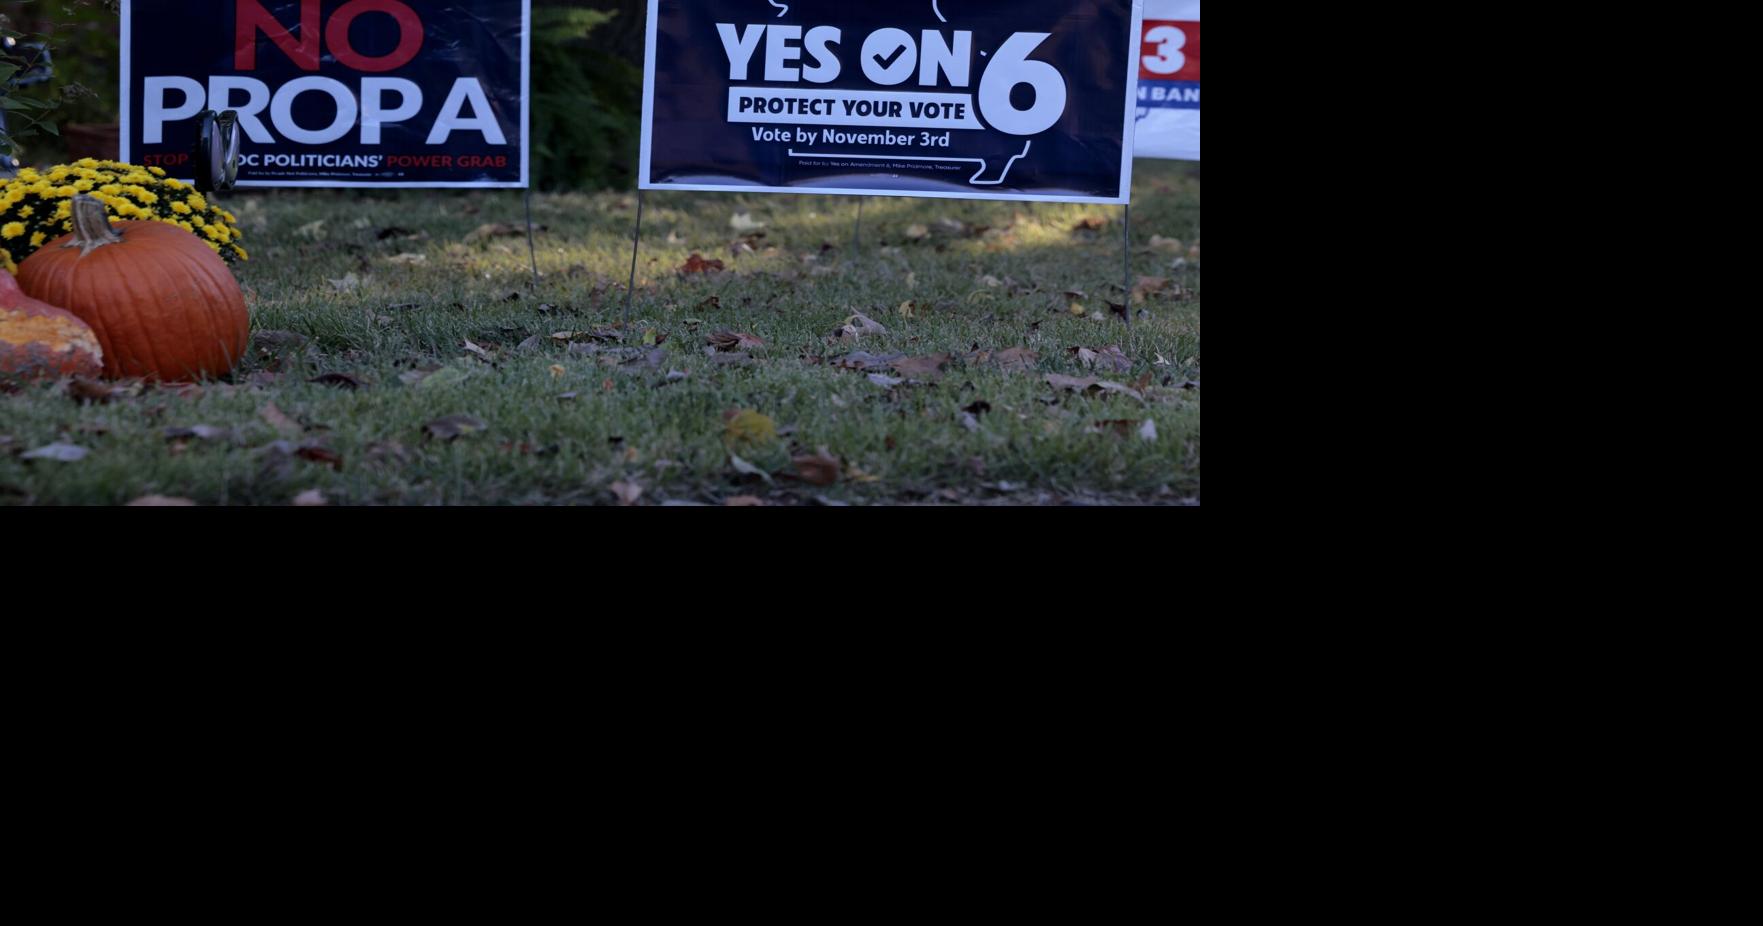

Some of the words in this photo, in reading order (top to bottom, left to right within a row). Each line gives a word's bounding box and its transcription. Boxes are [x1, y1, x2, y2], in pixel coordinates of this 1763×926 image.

[235, 0, 425, 73] NO
[715, 23, 842, 84] YES
[860, 27, 972, 87] ON
[1142, 25, 1186, 74] 3
[142, 75, 423, 145] PROP
[425, 77, 507, 145] A
[738, 96, 836, 117] PROTECT
[842, 99, 902, 118] YOUR
[909, 100, 965, 120] VOTE
[977, 32, 1067, 135] 6
[143, 153, 189, 166] STOP
[387, 155, 452, 167] POWER
[456, 155, 507, 168] GRAB
[751, 127, 791, 143] Vote
[795, 128, 817, 147] by
[821, 130, 916, 147] November
[919, 132, 950, 148] 3rd
